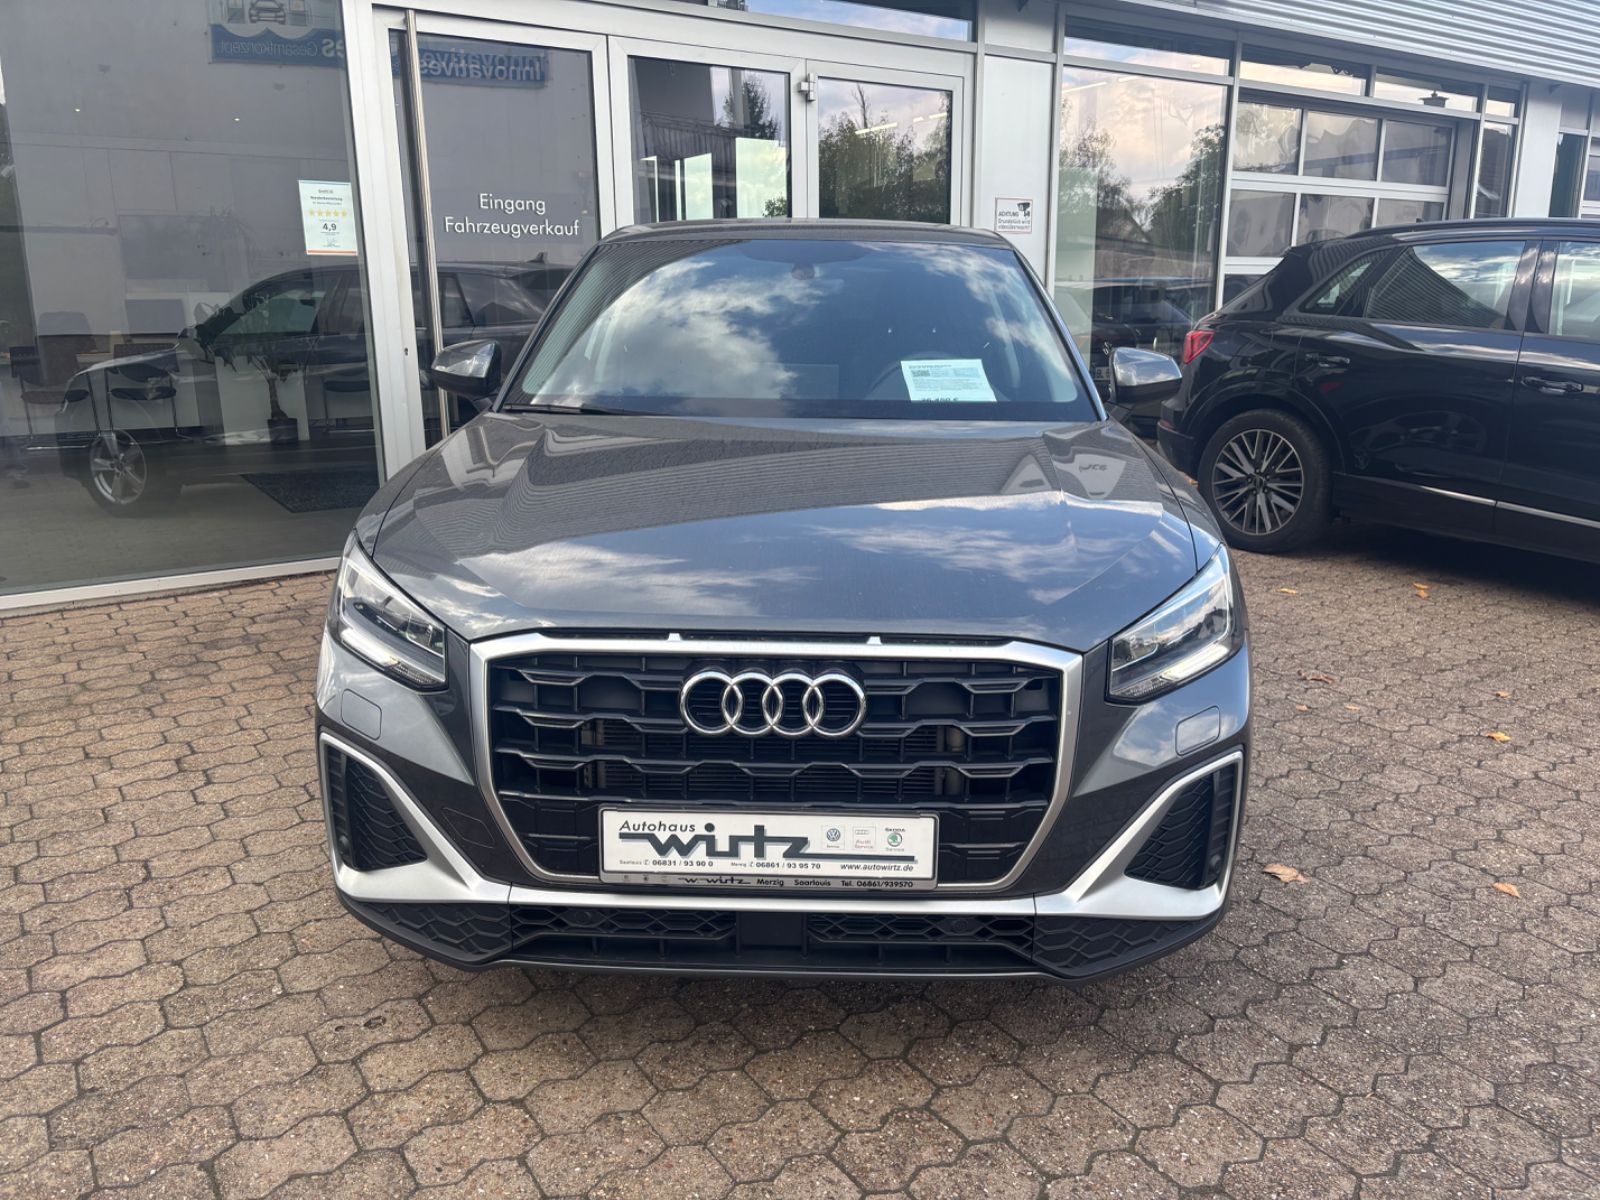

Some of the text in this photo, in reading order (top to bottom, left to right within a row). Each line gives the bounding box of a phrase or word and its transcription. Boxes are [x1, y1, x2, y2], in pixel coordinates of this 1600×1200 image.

[479, 193, 546, 215] Eingang
[322, 223, 337, 231] 4,9
[444, 216, 580, 239] Fahrzeugverkauf
[619, 820, 696, 832] Autohaus
[840, 864, 914, 872] www.autowirtz.de
[757, 879, 784, 887] Merzig
[794, 879, 831, 887] Saarlouis
